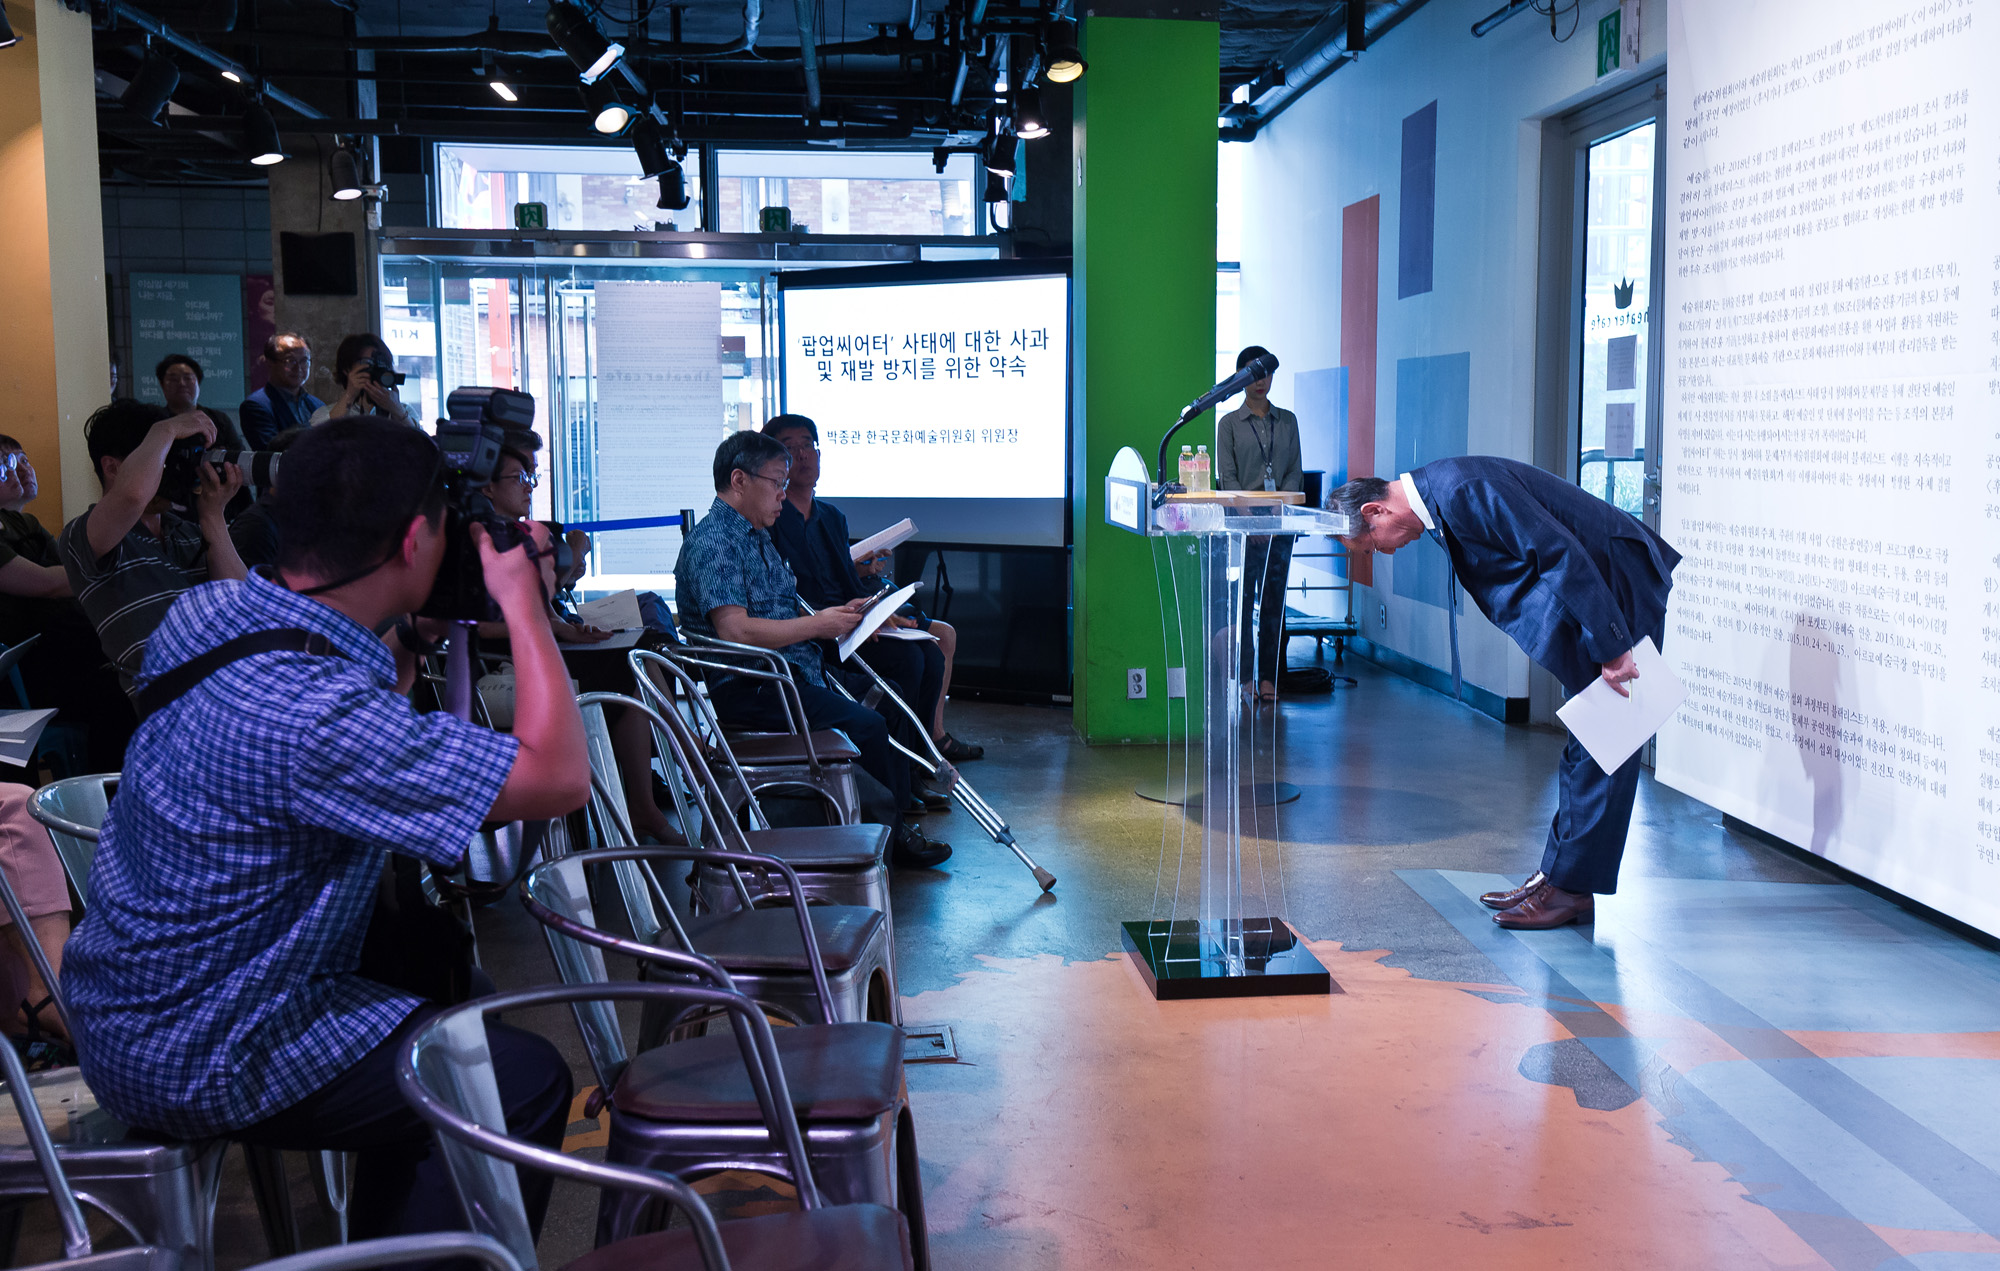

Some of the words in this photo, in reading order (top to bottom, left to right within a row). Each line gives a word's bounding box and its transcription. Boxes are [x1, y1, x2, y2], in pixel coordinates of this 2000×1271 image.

[797, 333, 894, 357] '팝업씨어터'
[902, 331, 956, 354] 사태에
[965, 329, 1001, 353] 대한
[1010, 327, 1050, 351] 사과
[817, 360, 833, 382] 및
[841, 359, 875, 382] 재발
[883, 357, 937, 381] 방지를
[945, 356, 981, 379] 위한
[989, 355, 1027, 378] 약속
[827, 429, 861, 445] 박종관
[866, 428, 976, 445] 한국문화예술위원회
[981, 428, 1019, 444] 위원장
